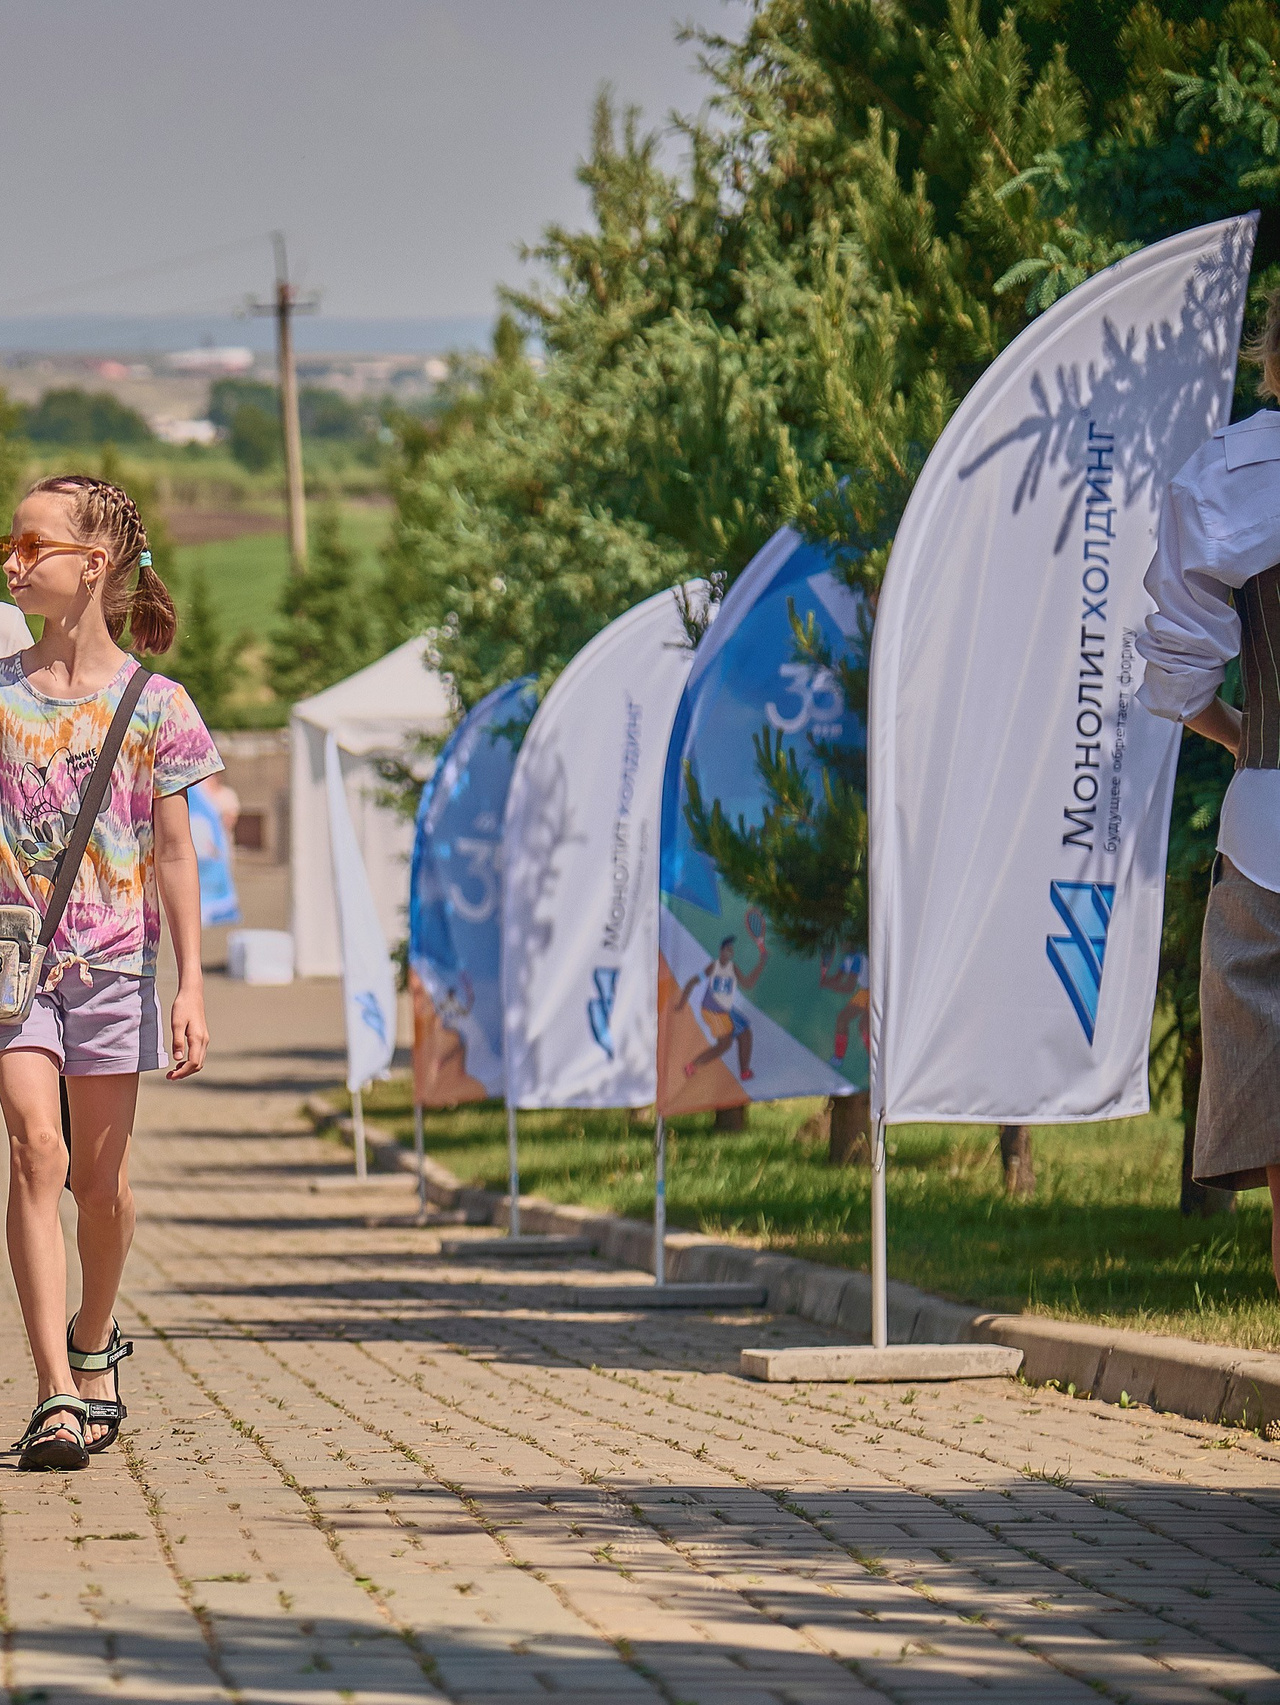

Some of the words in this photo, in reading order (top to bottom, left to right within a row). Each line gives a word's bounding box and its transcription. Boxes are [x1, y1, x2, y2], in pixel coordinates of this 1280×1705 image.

[1120, 627, 1138, 687] форму
[1112, 691, 1130, 772] обретает
[1103, 776, 1121, 854] будущее
